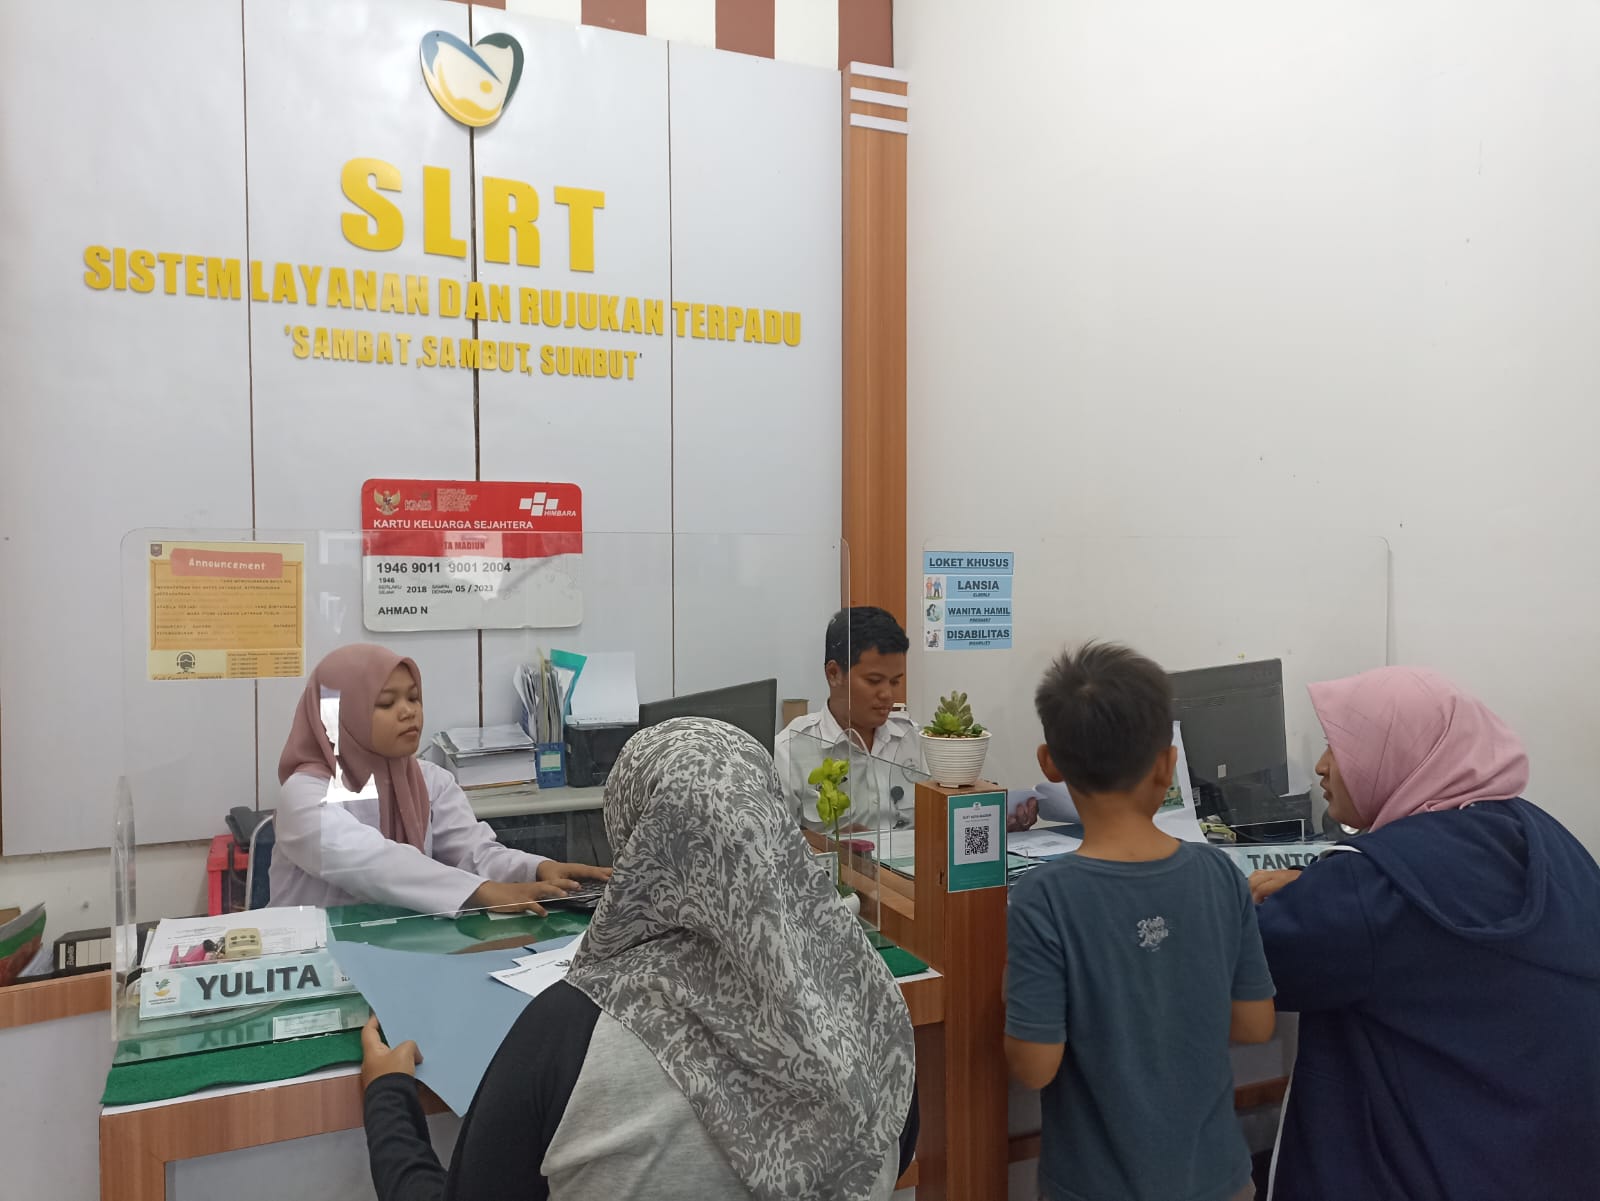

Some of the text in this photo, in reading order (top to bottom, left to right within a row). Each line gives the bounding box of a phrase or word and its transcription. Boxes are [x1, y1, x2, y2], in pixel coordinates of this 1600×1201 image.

[340, 157, 606, 273] SLRT
[83, 245, 802, 347] SISTEM LAYANAN DAN RUJUKAN TERPADU
[373, 519, 534, 530] KARTU KELUARGA SEJAHTERA
[188, 557, 266, 571] Announcement
[376, 562, 512, 574] 1946 9011 9001 2004
[928, 557, 1009, 568] LOKET KHUSUS
[406, 585, 427, 593] 2018
[455, 585, 466, 593] 05
[474, 584, 494, 592] 2023
[957, 580, 1000, 590] LANSIA
[378, 606, 428, 615] AHMAD N
[948, 607, 1011, 616] WANITA HAMIL
[946, 629, 1010, 639] DISABILITAS
[196, 964, 321, 1001] YULITA
